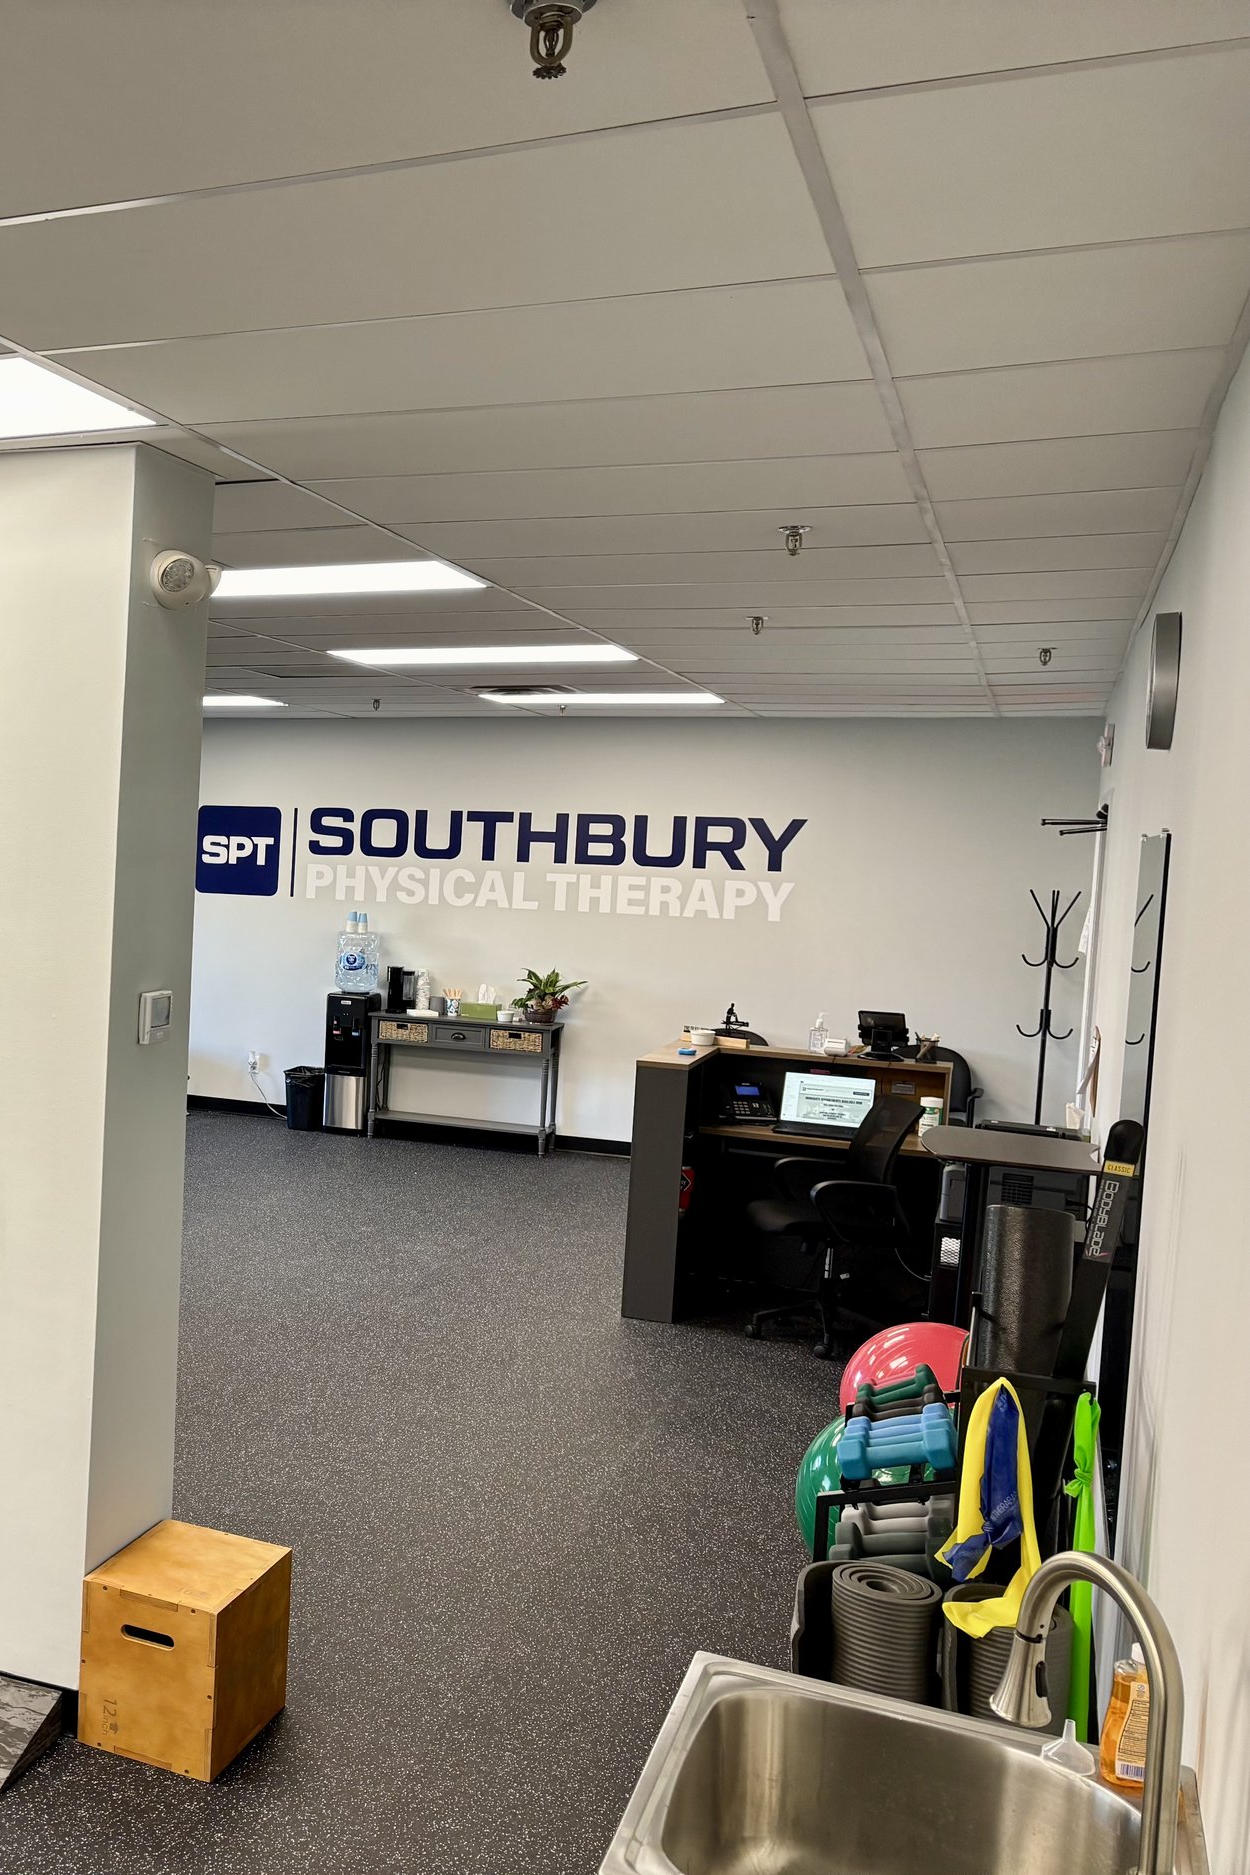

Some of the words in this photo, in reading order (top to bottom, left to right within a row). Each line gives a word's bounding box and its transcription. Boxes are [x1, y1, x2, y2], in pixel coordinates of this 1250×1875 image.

[201, 835, 274, 865] SPT
[308, 807, 808, 872] SOUTHBURY
[305, 863, 539, 910] PHYSICAL
[546, 872, 796, 922] THERAPY
[1107, 1163, 1132, 1174] CLASSIC
[103, 1698, 117, 1717] 12
